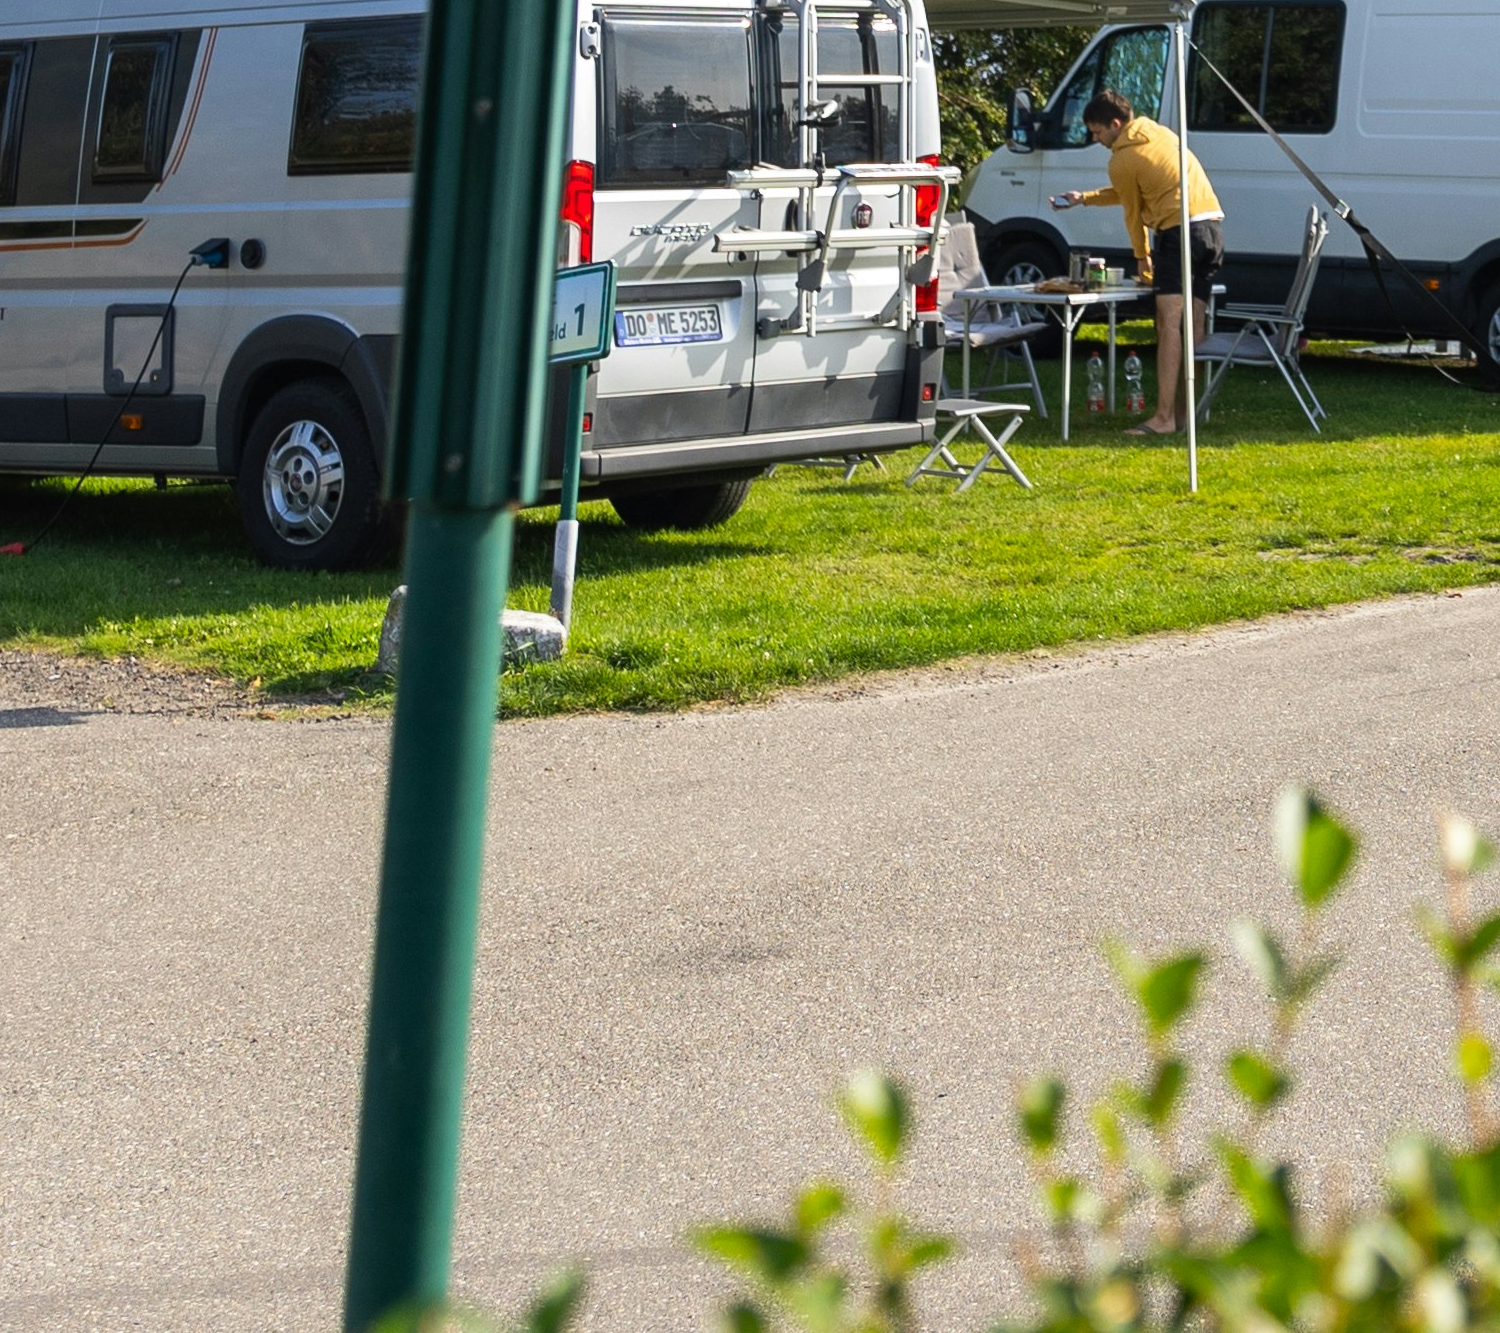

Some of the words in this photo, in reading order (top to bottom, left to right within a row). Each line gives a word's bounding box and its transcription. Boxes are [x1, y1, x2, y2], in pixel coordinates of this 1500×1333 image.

[549, 322, 566, 341] eld
[574, 302, 585, 336] 1
[680, 310, 718, 334] 5253
